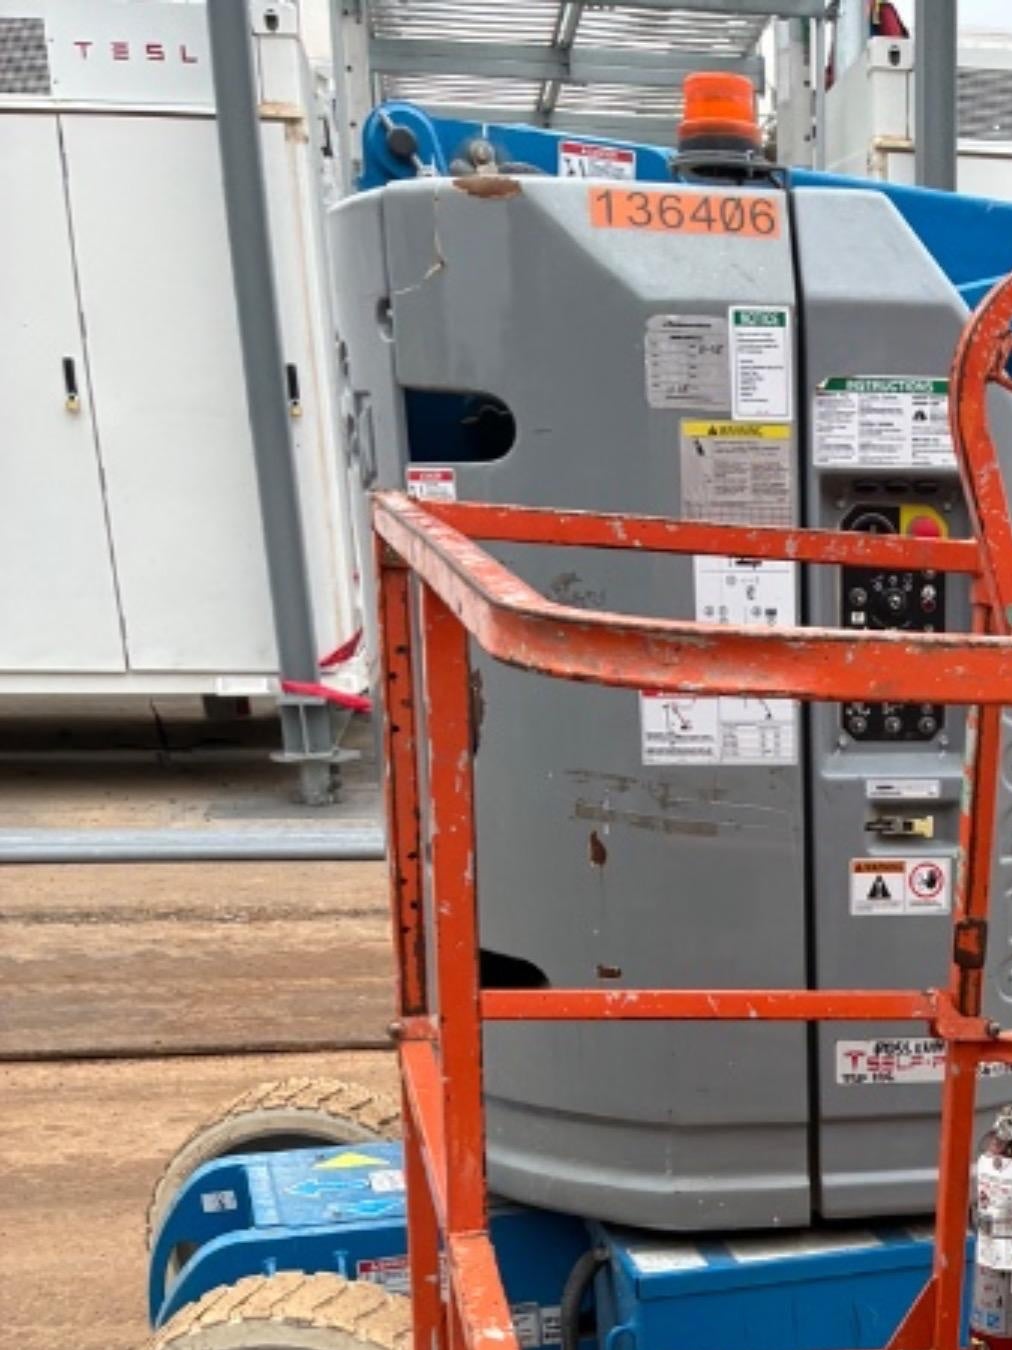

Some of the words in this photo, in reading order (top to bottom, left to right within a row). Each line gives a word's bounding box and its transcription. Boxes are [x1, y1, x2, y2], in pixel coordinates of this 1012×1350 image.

[73, 41, 198, 63] TESL
[596, 189, 776, 235] 136406
[846, 378, 933, 393] INSTRUCTIONS
